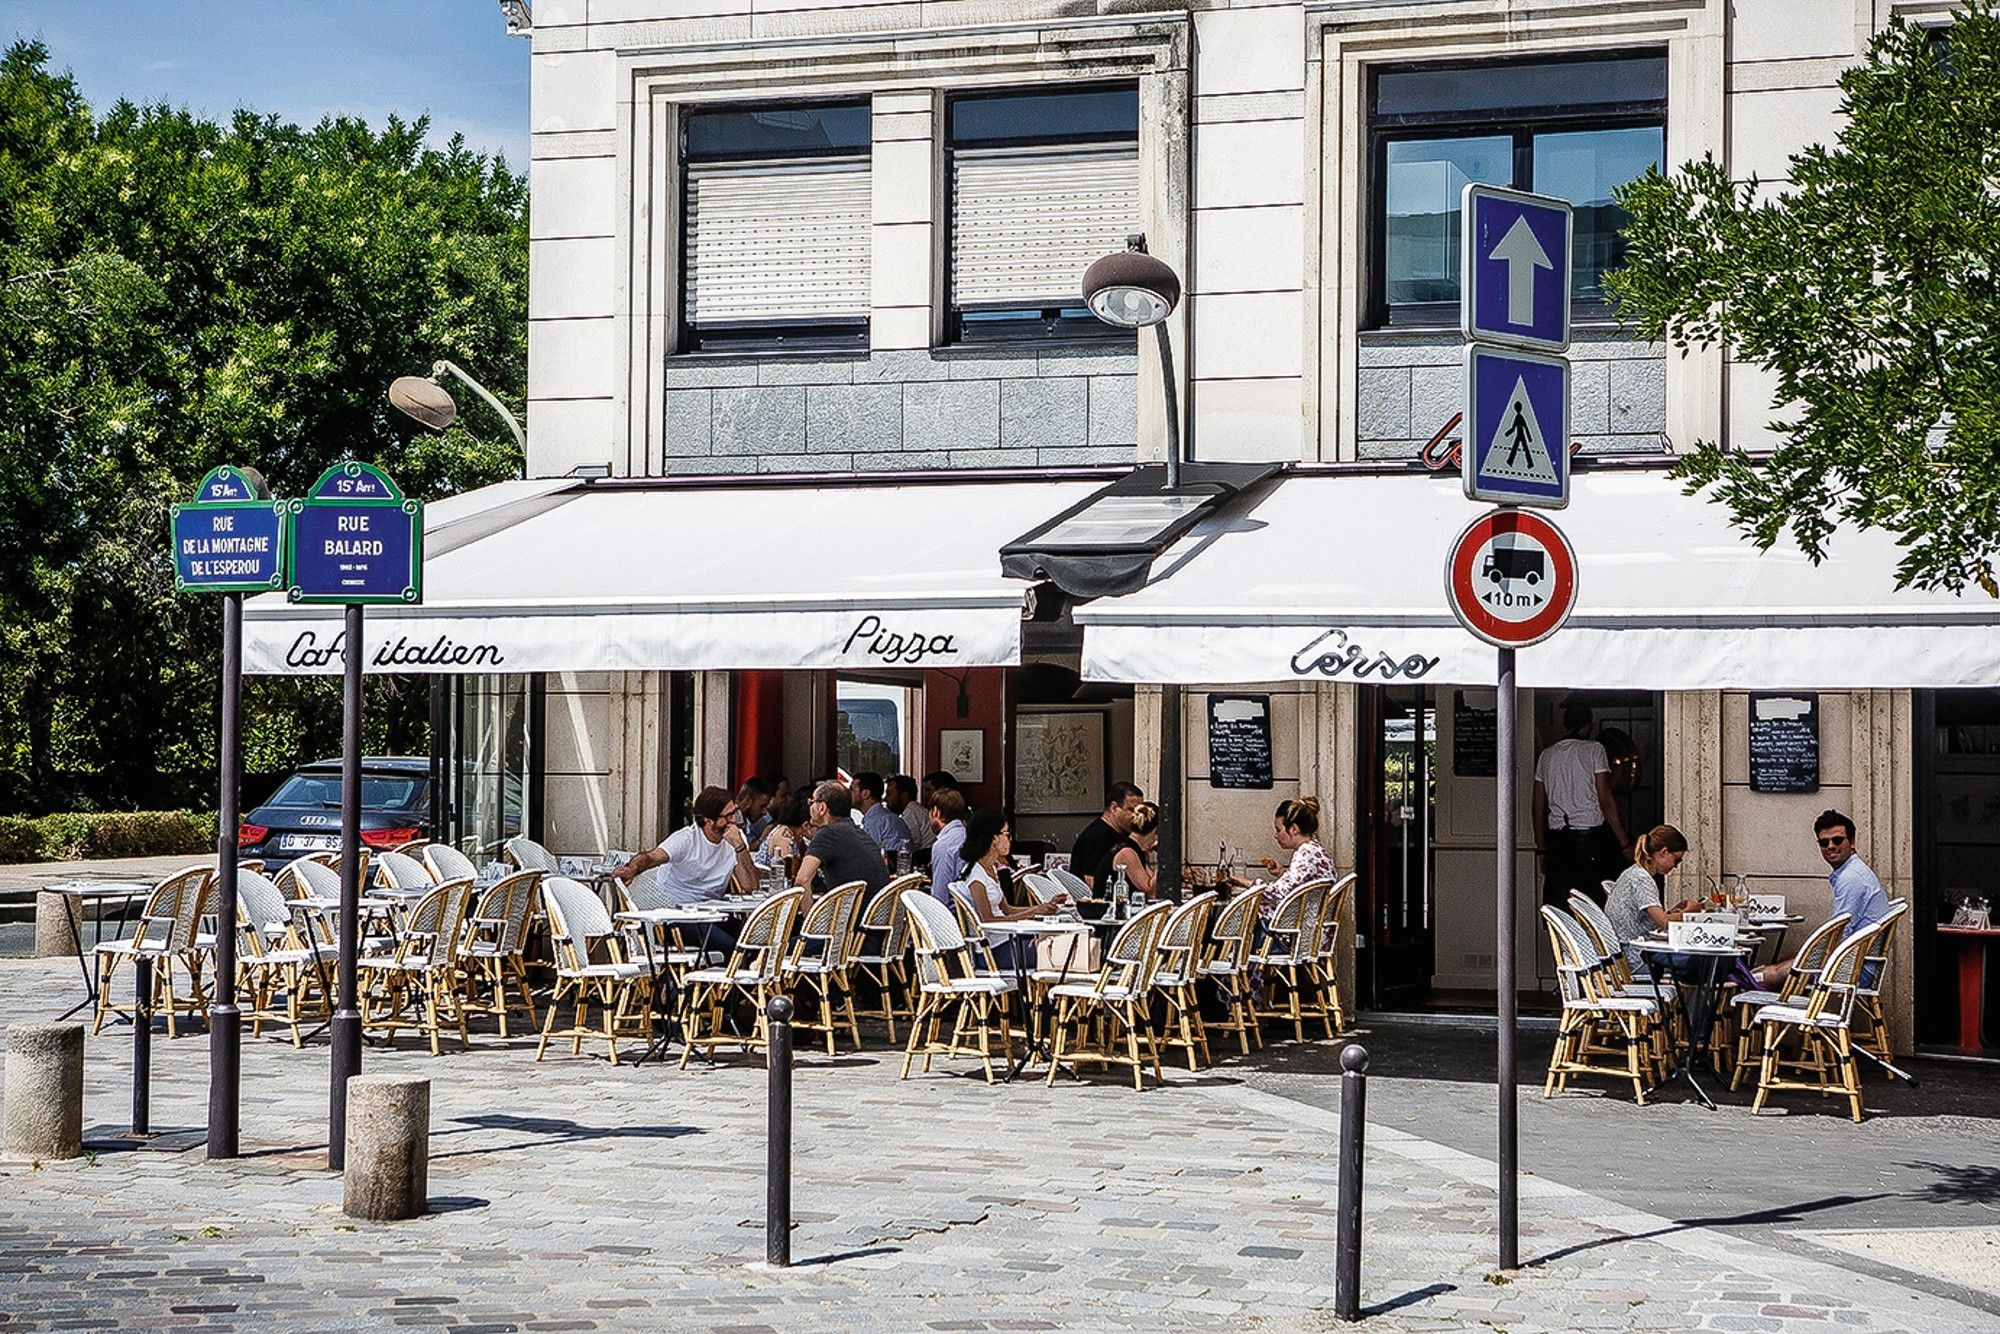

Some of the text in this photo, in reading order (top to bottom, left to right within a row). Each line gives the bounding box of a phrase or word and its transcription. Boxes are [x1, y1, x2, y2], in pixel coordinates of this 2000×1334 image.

[213, 516, 234, 532] RUE
[338, 515, 370, 532] RUE
[183, 536, 269, 555] DE LA MONTAGNE
[324, 540, 383, 556] BALARD
[191, 559, 260, 576] DE L'ESPEROU
[1494, 592, 1531, 607] 10 m
[841, 615, 959, 664] Pizza
[372, 634, 504, 666] italien
[1290, 629, 1441, 679] Corso
